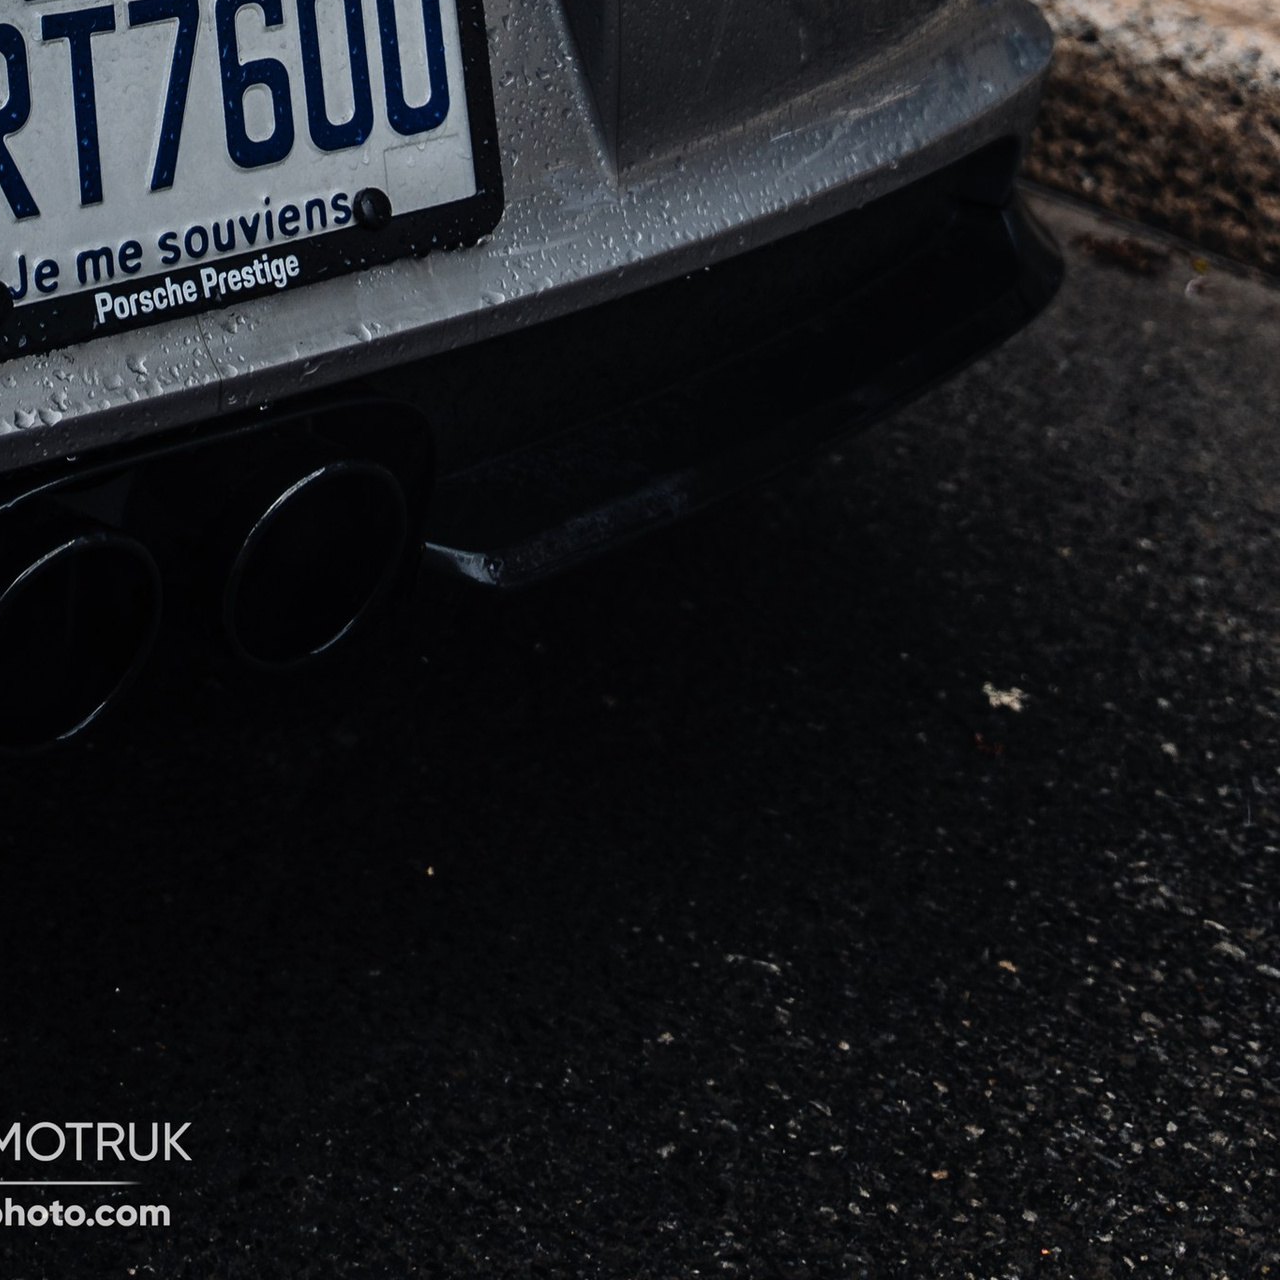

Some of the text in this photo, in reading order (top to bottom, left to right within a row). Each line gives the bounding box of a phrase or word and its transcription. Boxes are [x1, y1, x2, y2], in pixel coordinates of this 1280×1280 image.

[11, 190, 352, 301] Je me souviens
[94, 251, 301, 324] Porsche Prestige
